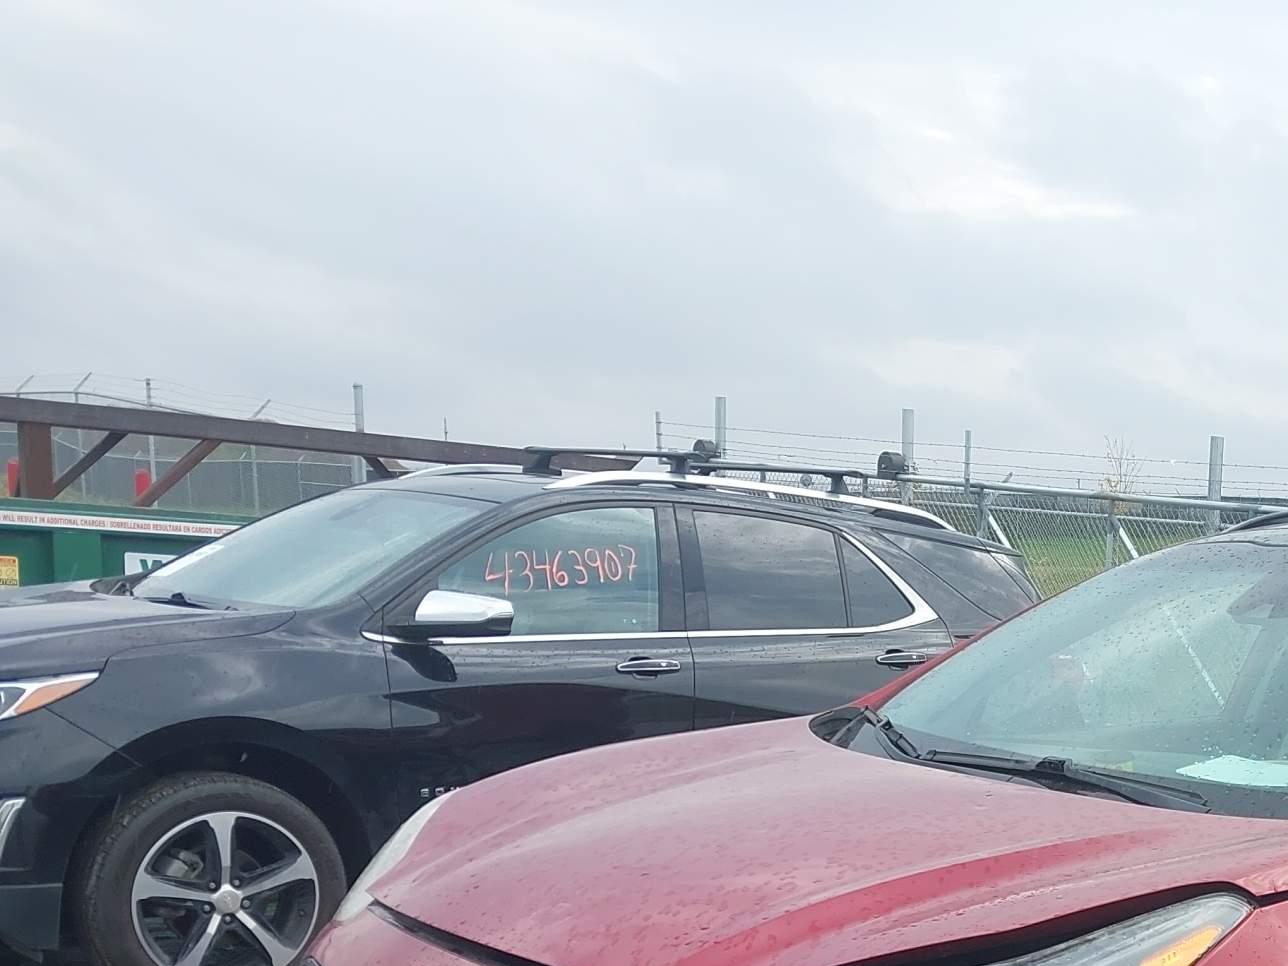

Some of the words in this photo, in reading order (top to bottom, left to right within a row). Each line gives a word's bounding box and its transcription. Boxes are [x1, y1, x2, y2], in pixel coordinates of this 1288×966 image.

[2, 513, 16, 522] WILL
[16, 515, 38, 523] RESULT
[39, 516, 45, 524] IN
[46, 517, 78, 526] ADDITIONAL
[80, 519, 106, 528] CHARGES
[183, 525, 191, 533] EN
[485, 544, 638, 596] 43463907
